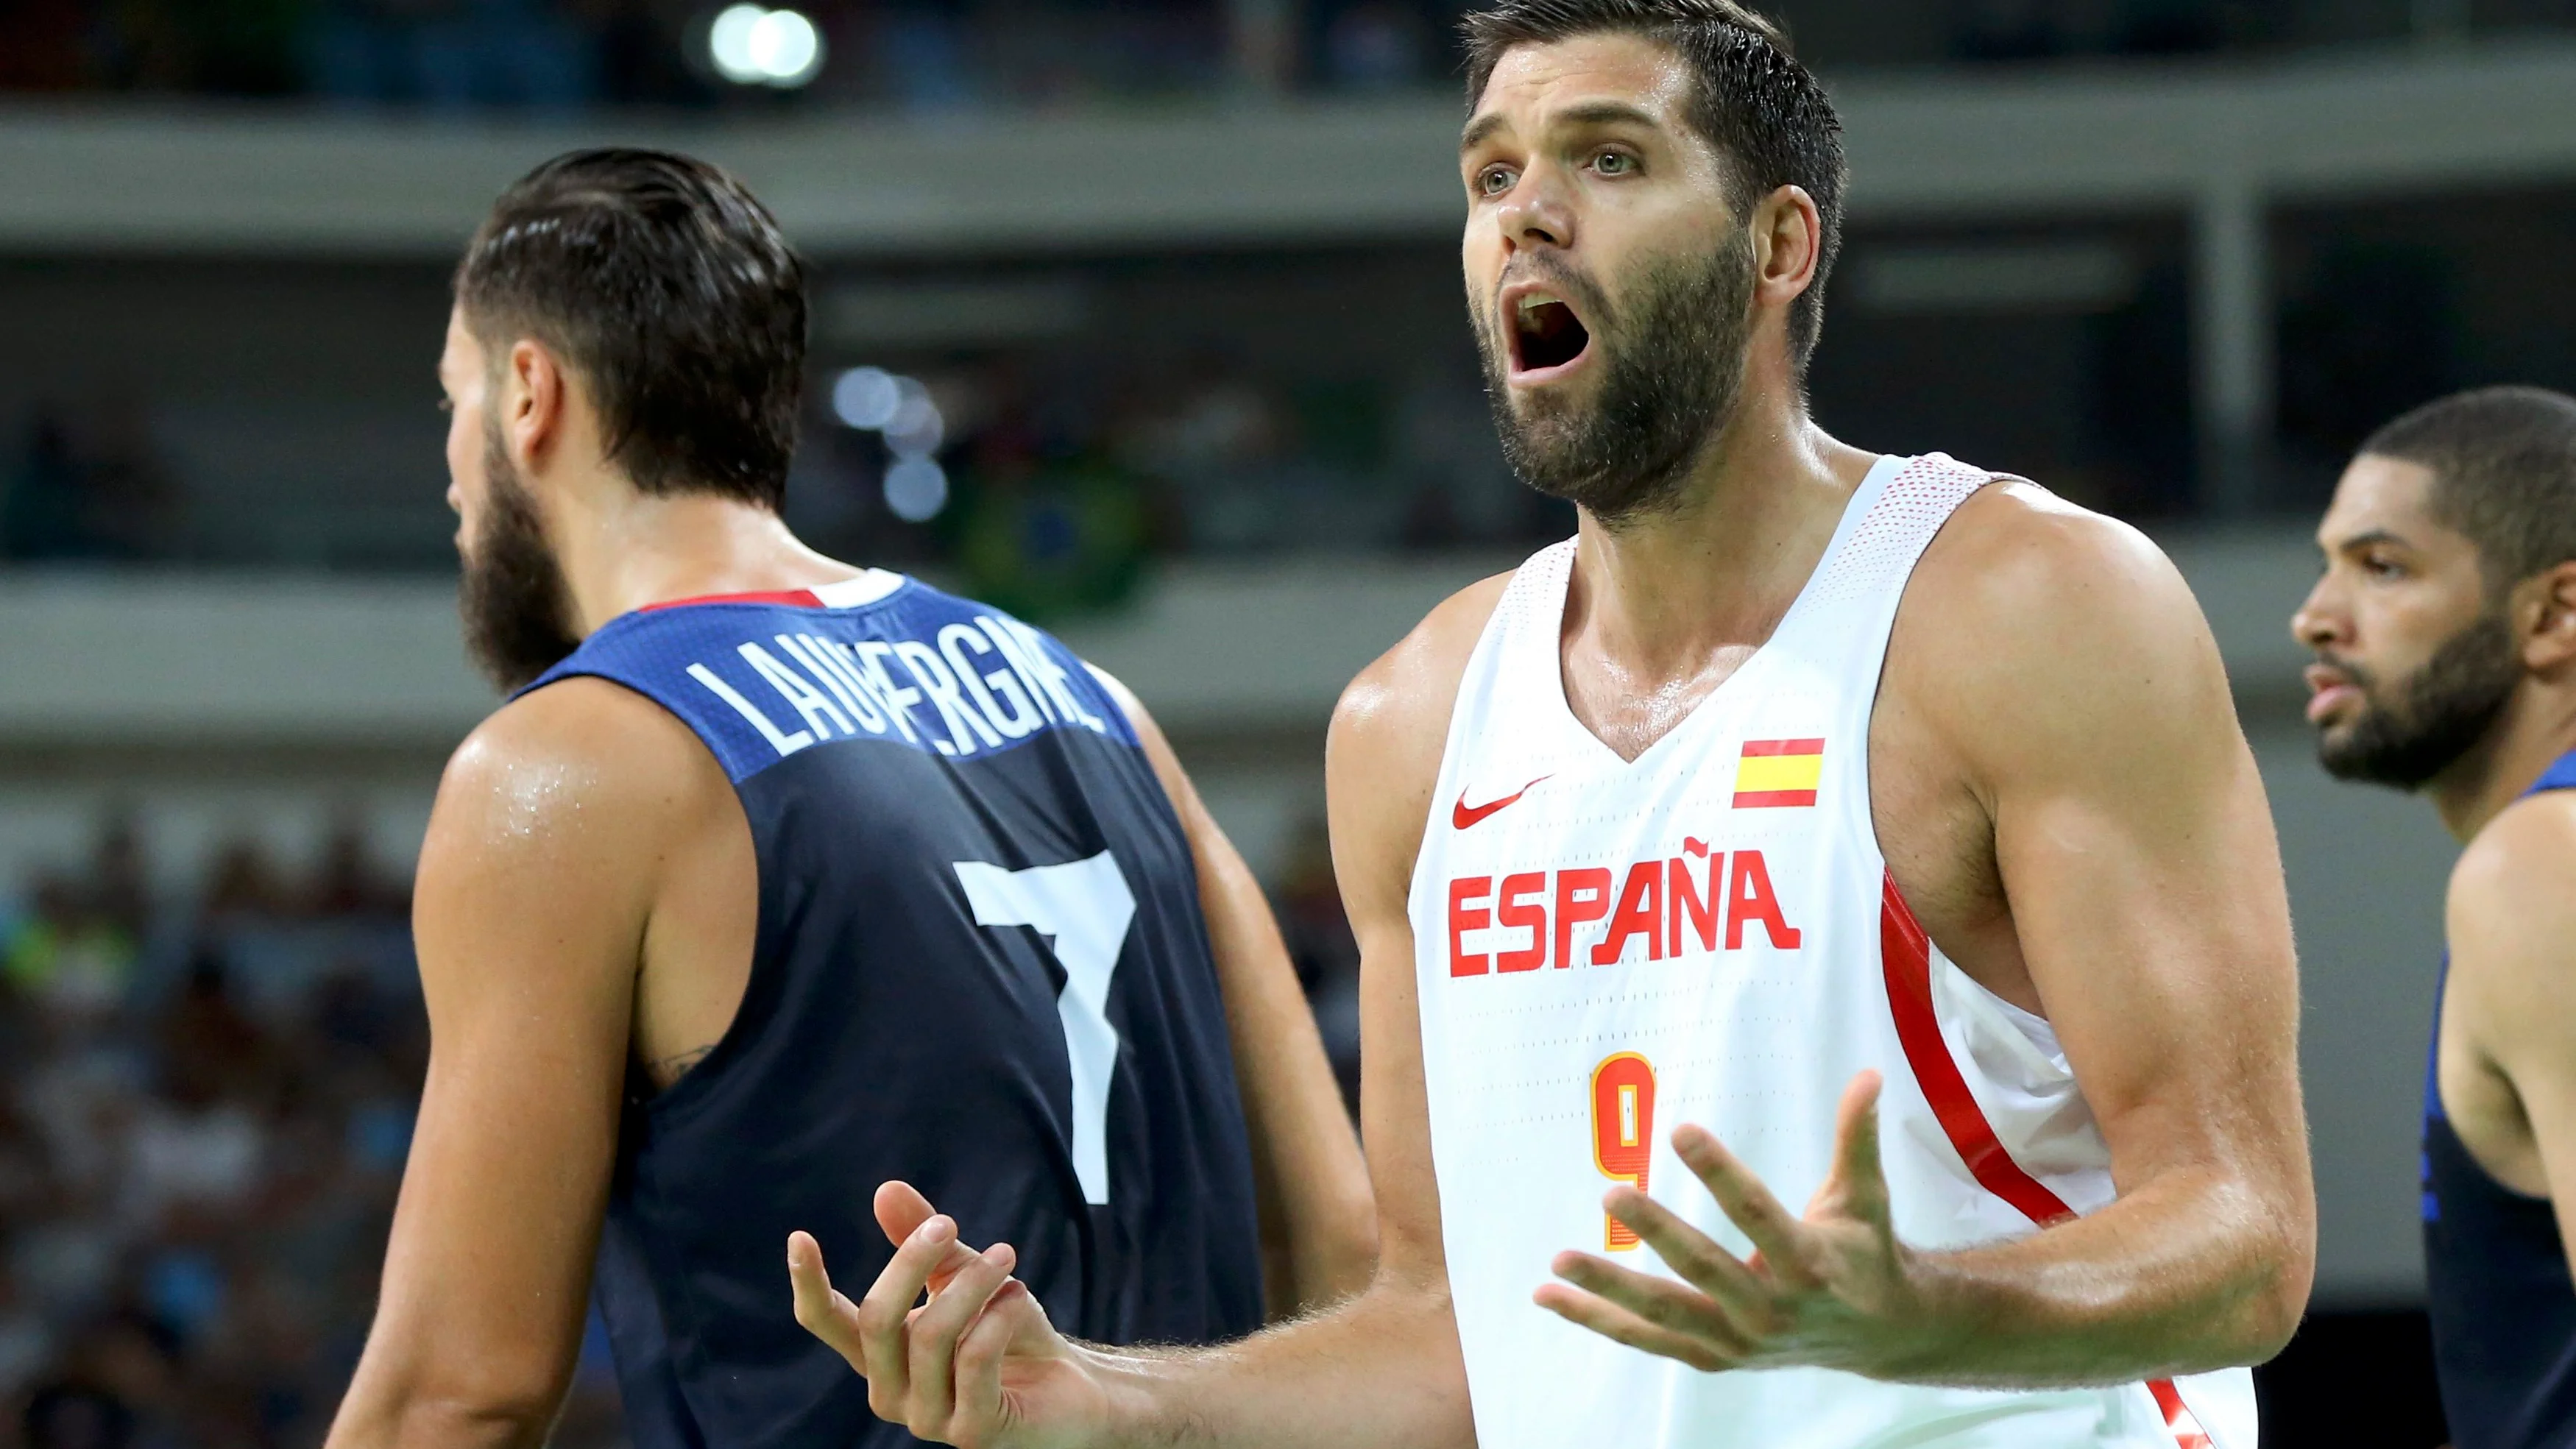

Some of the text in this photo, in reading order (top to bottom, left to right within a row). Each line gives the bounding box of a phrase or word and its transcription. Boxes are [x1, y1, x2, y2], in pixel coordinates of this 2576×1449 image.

[1448, 836, 1801, 977] ESPAÑA
[952, 849, 1137, 1205] 7
[1590, 1050, 1657, 1252] 9
